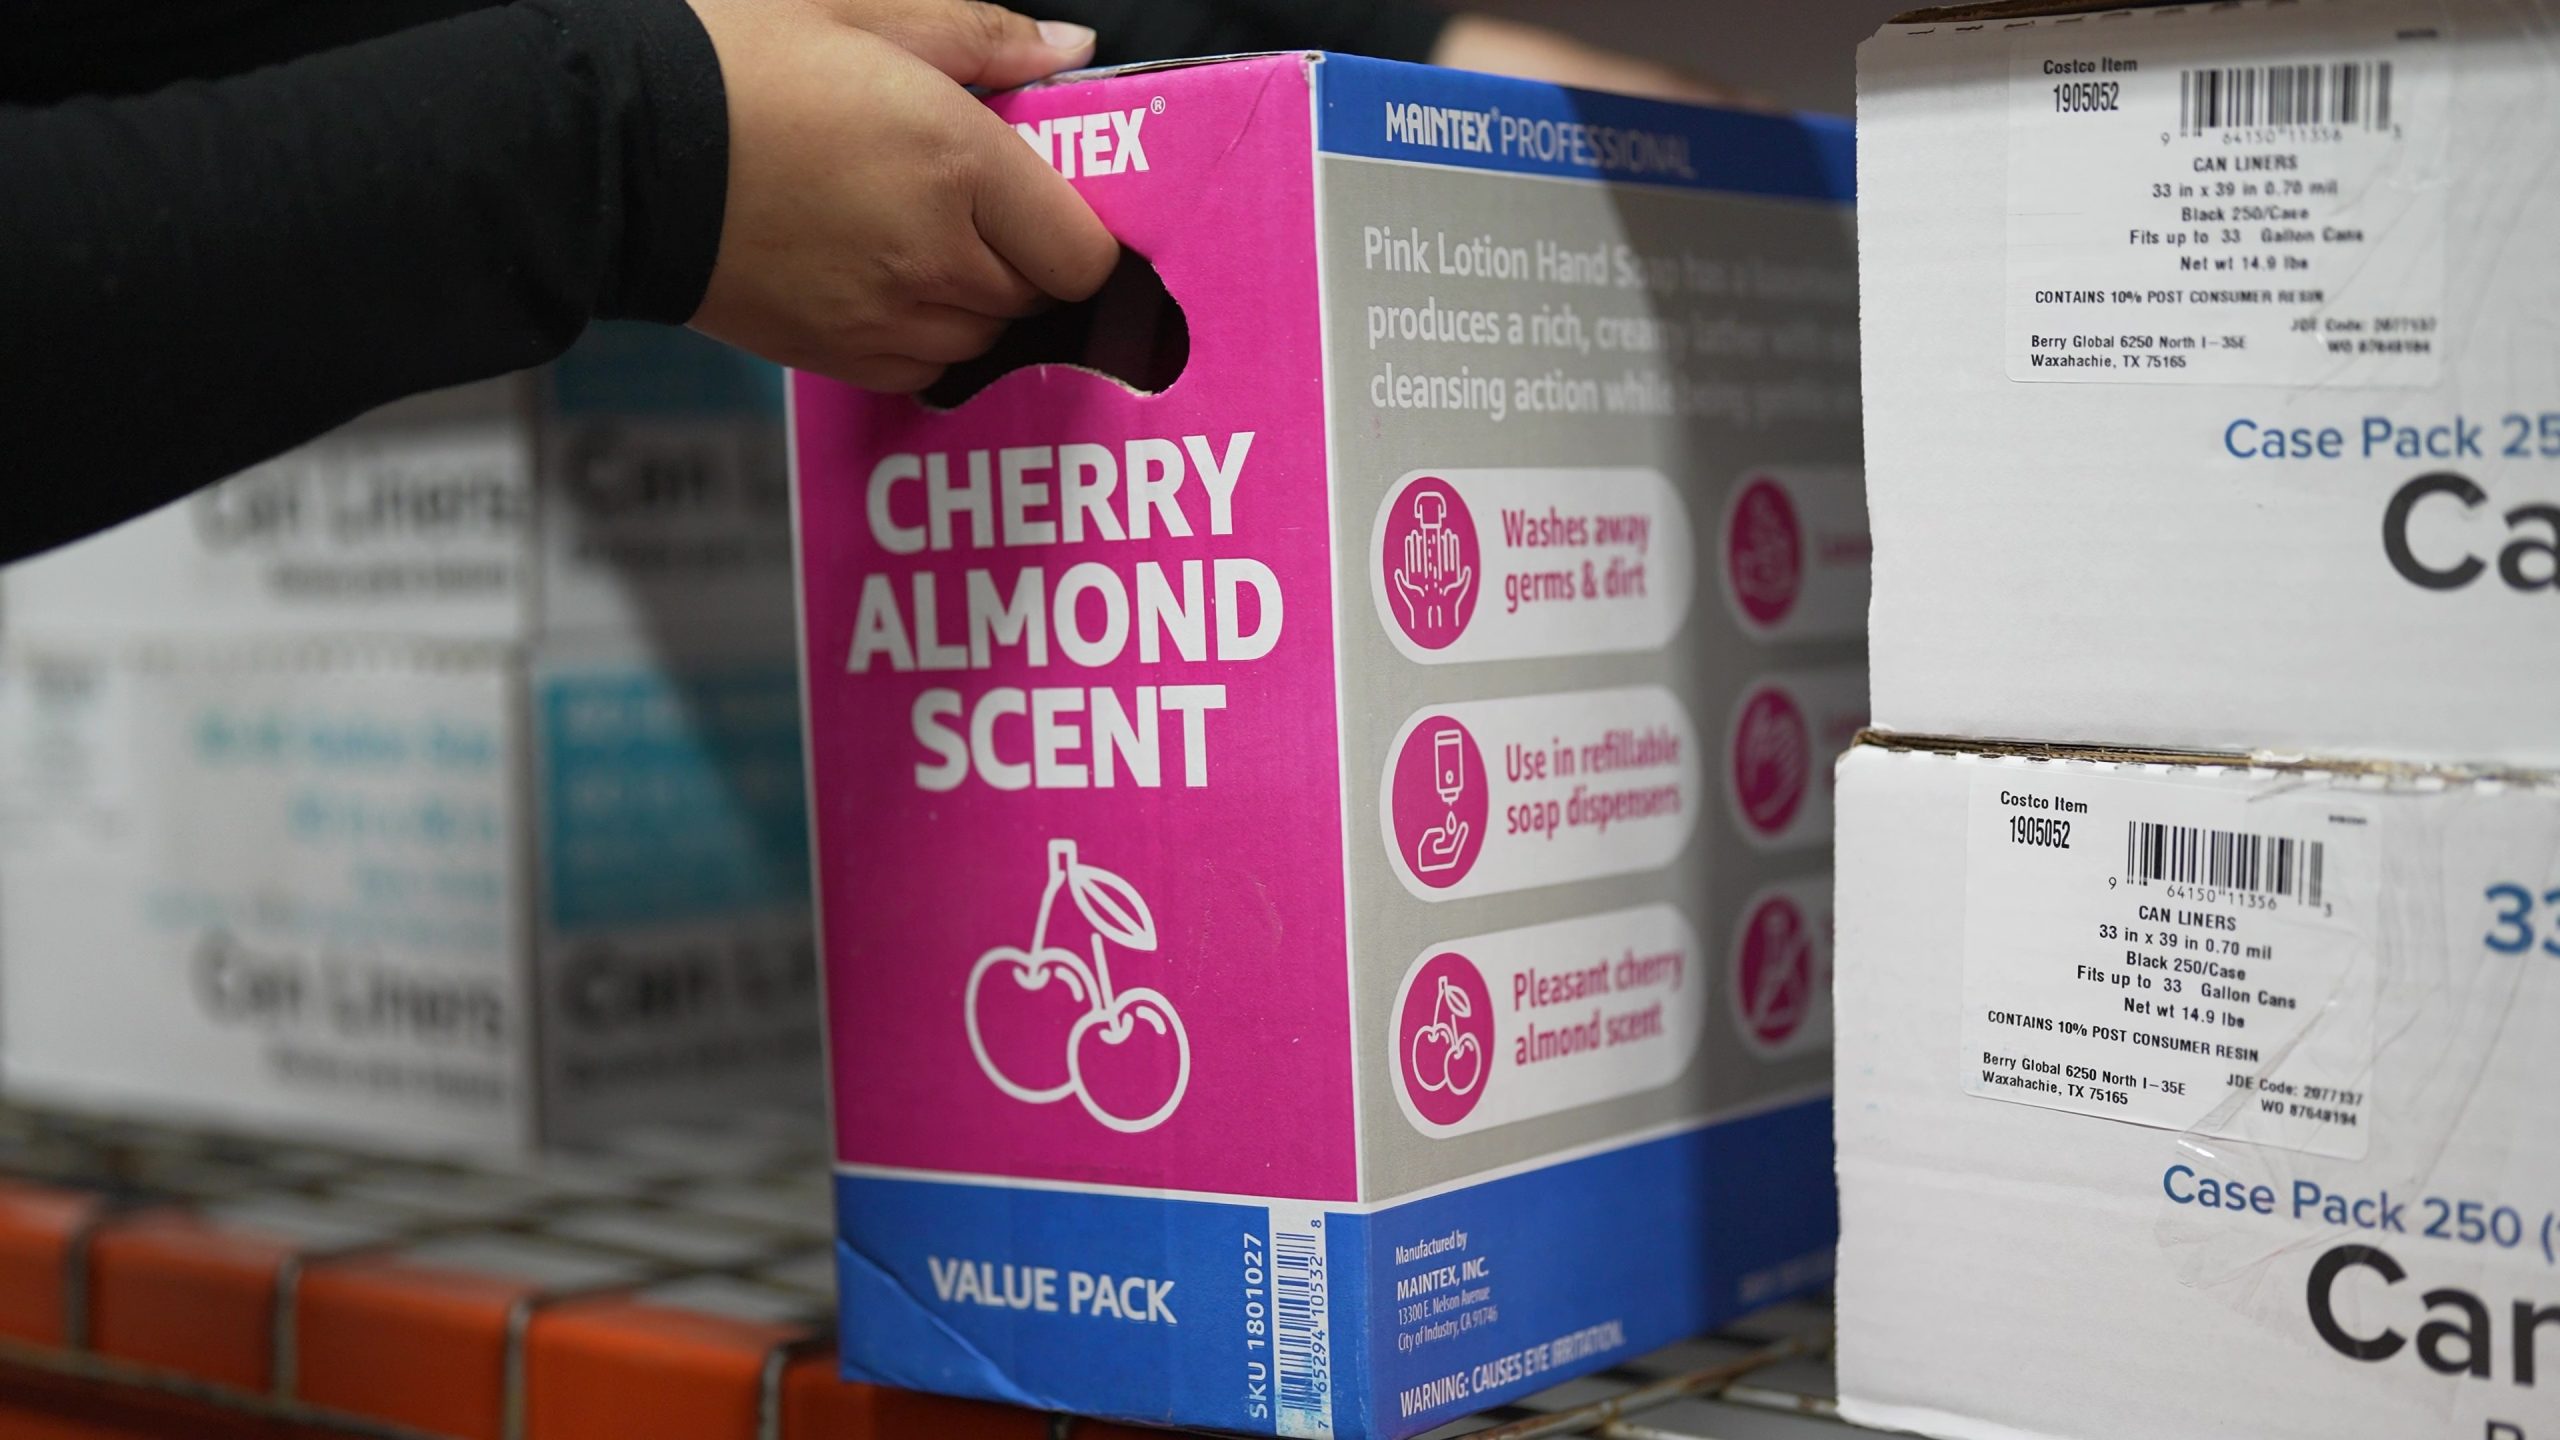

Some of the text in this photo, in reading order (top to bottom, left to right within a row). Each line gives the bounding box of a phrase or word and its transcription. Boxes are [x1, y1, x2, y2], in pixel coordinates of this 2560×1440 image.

[2043, 57, 2138, 75] Costco Item
[2053, 81, 2120, 112] 1905052
[1501, 116, 1695, 178] PROFESSIONAL
[2160, 132, 2171, 147] 9
[2193, 154, 2298, 172] CAN LINERS
[2152, 183, 2172, 198] 33
[2179, 183, 2193, 197] in
[2200, 187, 2209, 196] x
[2215, 182, 2235, 196] 39
[2243, 182, 2257, 196] in
[2181, 207, 2225, 222] Black
[1364, 226, 1431, 274] Pink
[1438, 232, 1529, 281] Lotion
[1537, 241, 1608, 287] Hand
[2130, 229, 2159, 244] Fits
[2167, 232, 2186, 247] up
[2194, 229, 2209, 244] to
[2221, 229, 2241, 243] 33
[2261, 227, 2314, 243] Gallon
[2180, 256, 2208, 271] Net
[2215, 257, 2233, 271] wt
[2035, 290, 2104, 304] CONTAINS
[2111, 290, 2142, 304] 10%
[2147, 290, 2183, 304] POST
[2189, 290, 2272, 304] CONSUMER
[1368, 296, 1500, 350] produces
[1507, 310, 1523, 345] a
[1531, 304, 1590, 353] rich,
[2031, 335, 2067, 351] Berry
[2073, 334, 2114, 349] Global
[2120, 335, 2153, 349] 6250
[2159, 335, 2195, 349] North
[2031, 354, 2187, 370] Waxahachie, TX 75165
[1371, 362, 1506, 421] cleansing
[1514, 369, 1598, 413] action
[2224, 418, 2344, 458] Case
[2362, 415, 2483, 458] Pack
[865, 431, 1256, 555] CHERRY
[1502, 506, 1650, 555] Washes away
[1505, 556, 1646, 614] germs & dirt
[846, 558, 1284, 674] ALMOND
[910, 684, 1227, 792] SCENT
[1505, 726, 1680, 783] Use in refillable
[1506, 783, 1681, 840] soap dispensers
[2000, 790, 2088, 814] Costco Item
[2009, 815, 2071, 849] 1905052
[2108, 876, 2118, 890] 9
[2166, 885, 2216, 903] 64150
[2228, 891, 2277, 911] 11356
[2138, 905, 2237, 932] CAN LINERS
[2099, 924, 2272, 960] 33 in x 39 in 0.70 mil
[1513, 948, 1685, 1012] Pleasant cherry
[2126, 950, 2246, 981] Black 250/Case
[2077, 965, 2297, 1009] Fits up to 33 Gallon Cans
[2124, 997, 2150, 1015] Net
[2157, 1003, 2174, 1018] wt
[2182, 1007, 2215, 1024] 14.9
[1515, 1003, 1663, 1066] almond scent
[1987, 1010, 2260, 1062] CONTAINS 10% POST CONSUMER RESIN
[1981, 1070, 2129, 1105] Waxahachie, TX 75165
[1982, 1052, 2017, 1070] Berry
[2021, 1057, 2061, 1076] Global
[2066, 1065, 2097, 1081] 6250
[2102, 1071, 2138, 1088] North
[2226, 1073, 2254, 1089] JDE
[2259, 1078, 2298, 1096] Code:
[1310, 1219, 1322, 1228] 8
[2162, 1164, 2276, 1214] Case
[2293, 1180, 2406, 1234] Pack
[2422, 1196, 2522, 1248] 250
[1395, 1229, 1468, 1265] Manufactured by
[927, 1255, 1178, 1325] VALUE PACK
[1309, 1256, 1325, 1315] 10532
[1397, 1256, 1489, 1301] MAINTEX, INC.
[1243, 1232, 1268, 1419] SKU 1801027
[1398, 1286, 1491, 1325] 13300 E. Nelson Avenue
[1398, 1332, 1414, 1354] City
[1415, 1329, 1424, 1345] of
[1424, 1319, 1459, 1341] Industry,
[1460, 1313, 1473, 1331] CA
[1311, 1329, 1328, 1393] 65294
[1400, 1371, 1469, 1418] WARNING:
[1472, 1351, 1522, 1393] CAUSES
[1524, 1343, 1550, 1376] EYE
